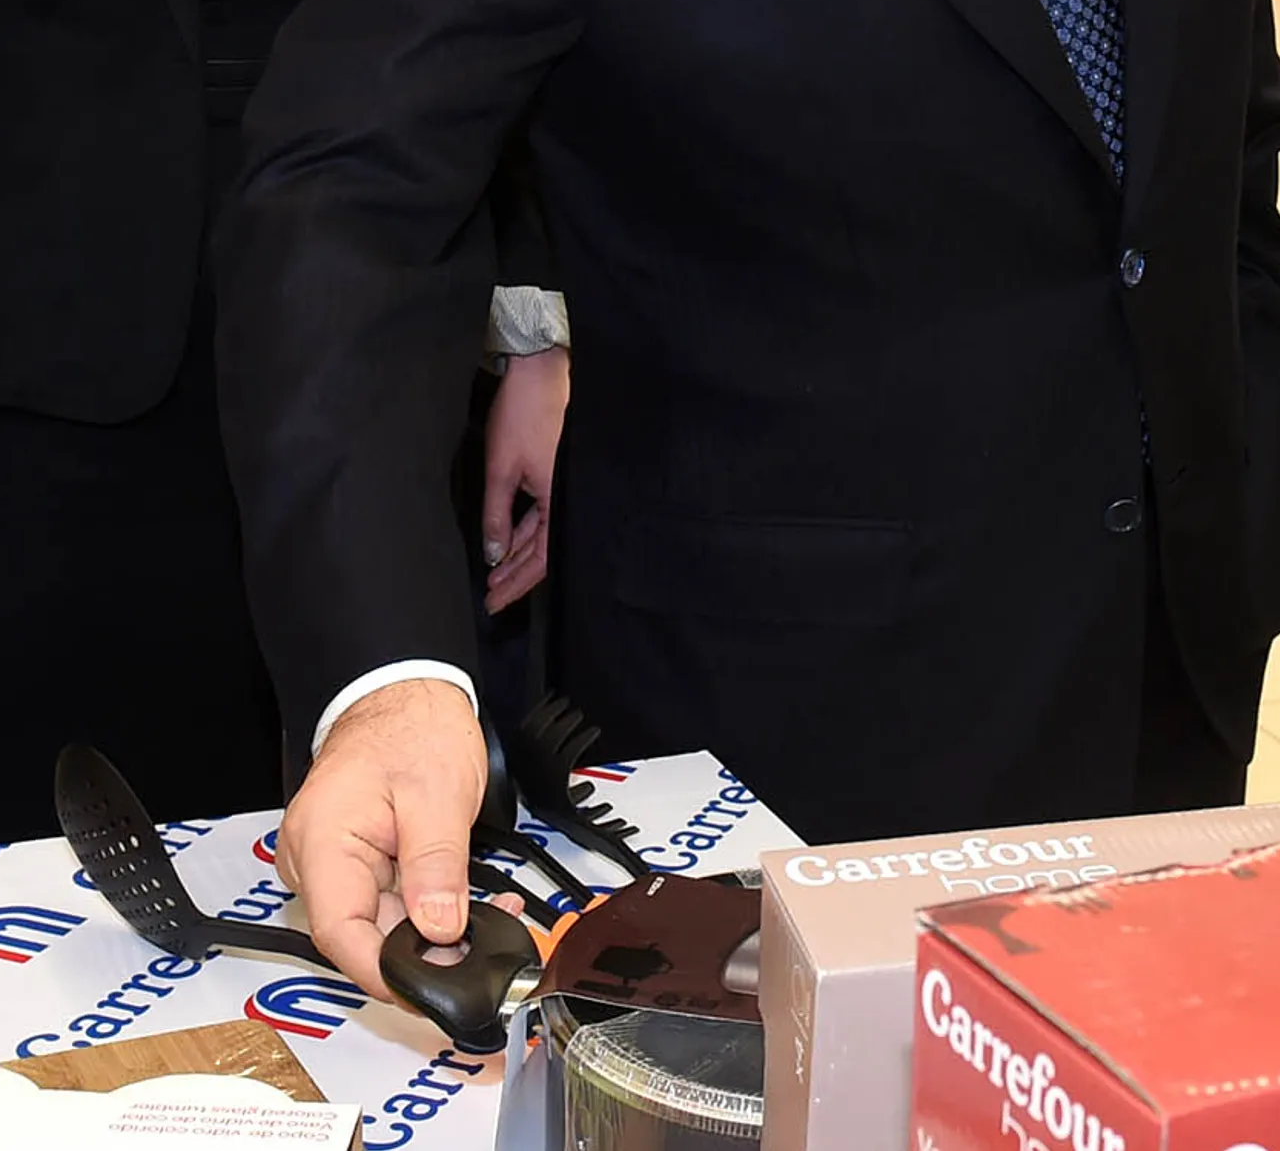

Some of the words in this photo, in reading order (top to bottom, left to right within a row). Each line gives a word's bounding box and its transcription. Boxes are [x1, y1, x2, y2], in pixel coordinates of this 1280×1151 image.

[785, 834, 1097, 888] Carrefour
[940, 863, 1117, 896] home
[211, 1105, 258, 1116] glass
